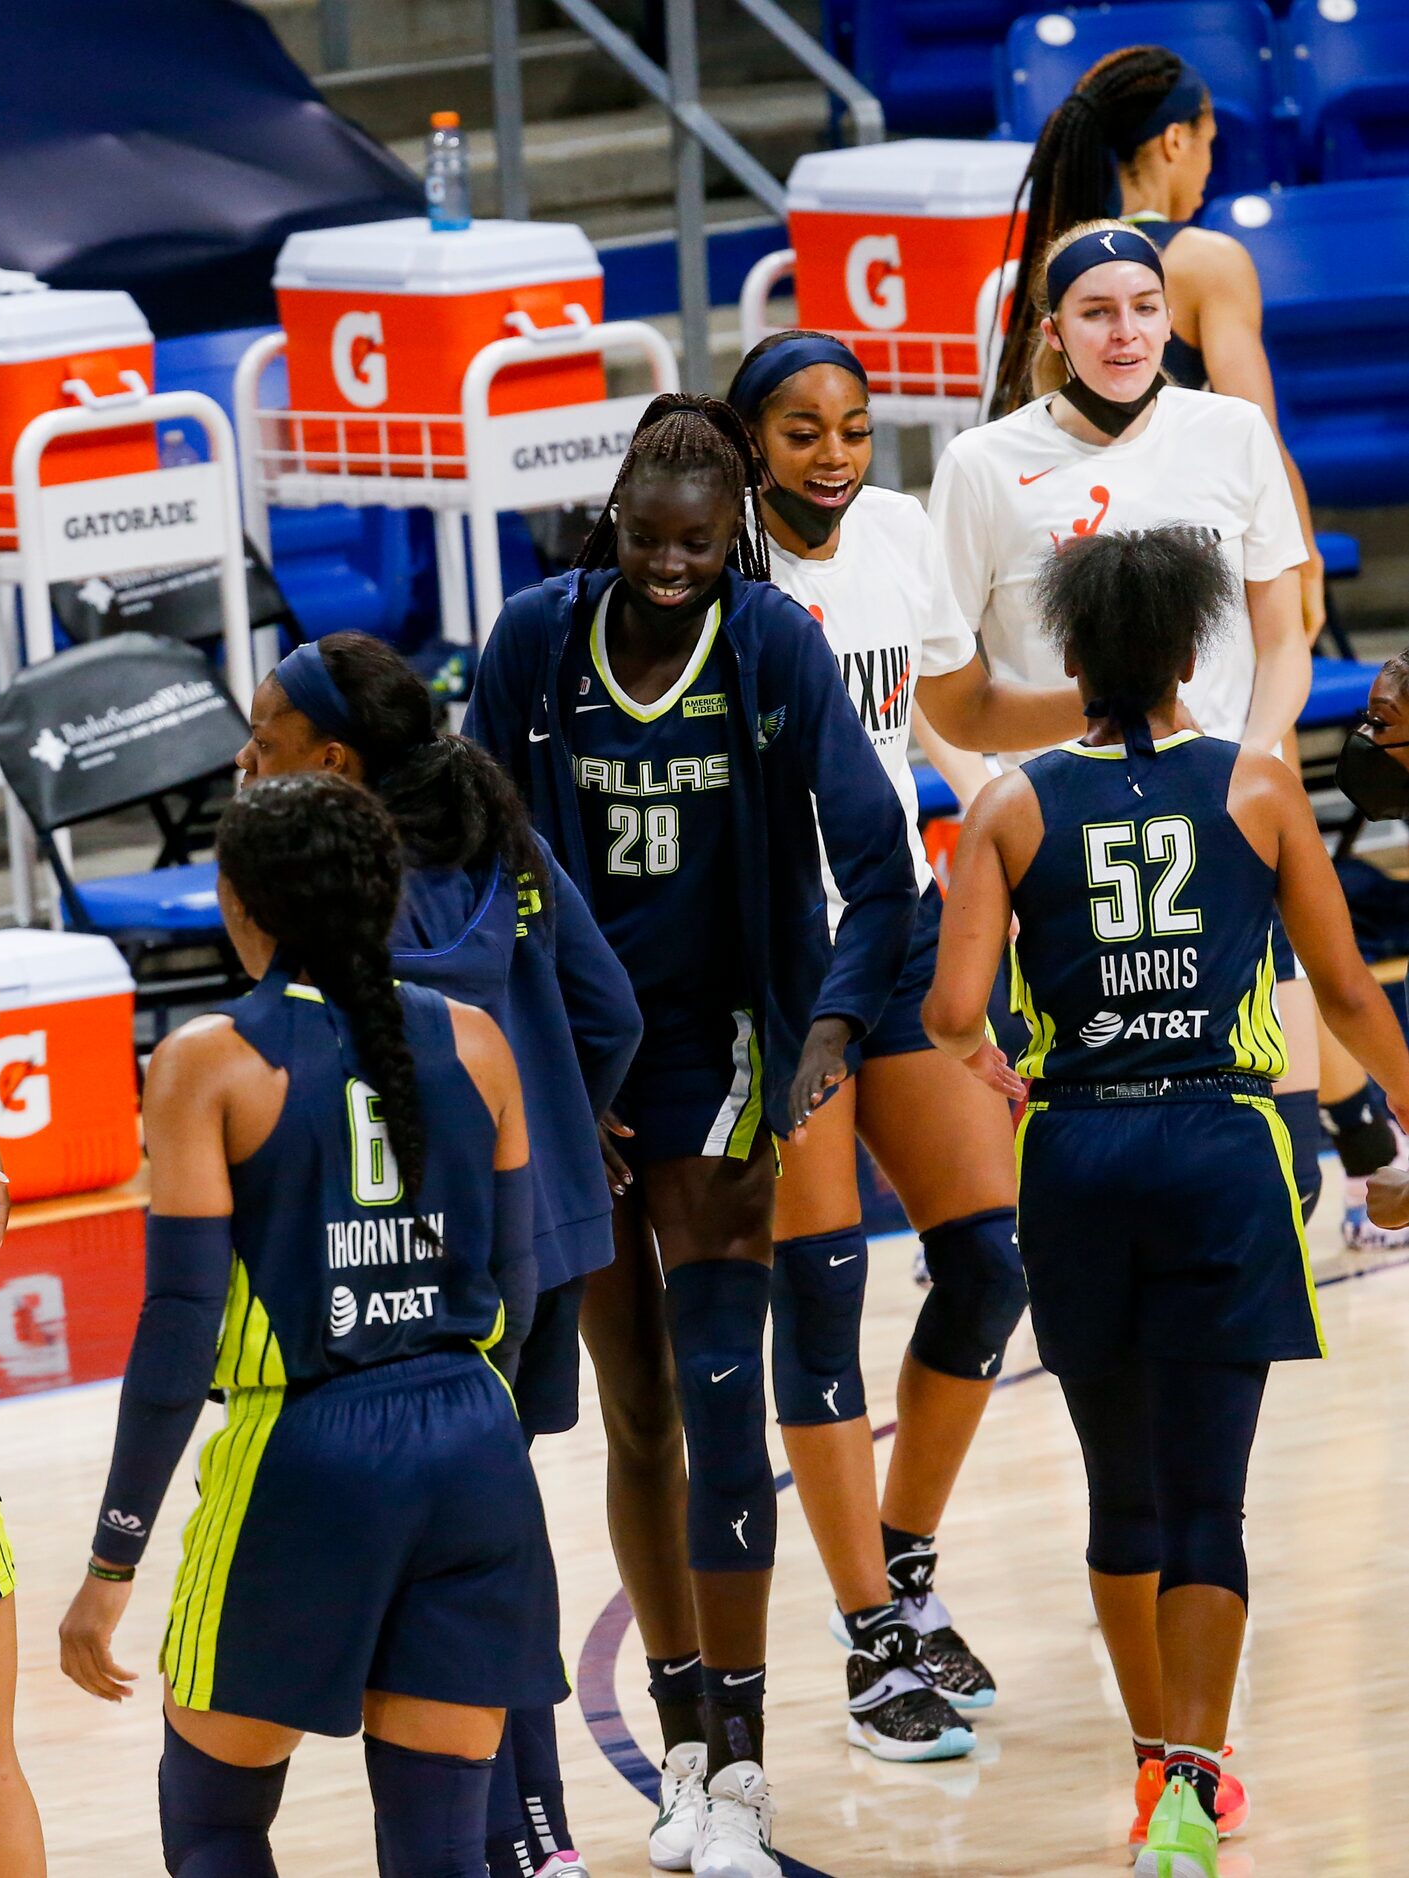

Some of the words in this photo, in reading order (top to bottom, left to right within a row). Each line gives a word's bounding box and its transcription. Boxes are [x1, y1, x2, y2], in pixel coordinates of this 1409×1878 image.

[845, 234, 907, 330] G
[332, 310, 388, 409] G
[513, 430, 636, 471] GATORAD
[64, 499, 198, 540] GATORADE
[608, 804, 679, 877] 28
[1082, 814, 1203, 943] 52
[1100, 947, 1198, 997] HARRIS
[1124, 1009, 1210, 1040] AT&T
[345, 1076, 404, 1207] 6
[364, 1286, 440, 1326] AT&T
